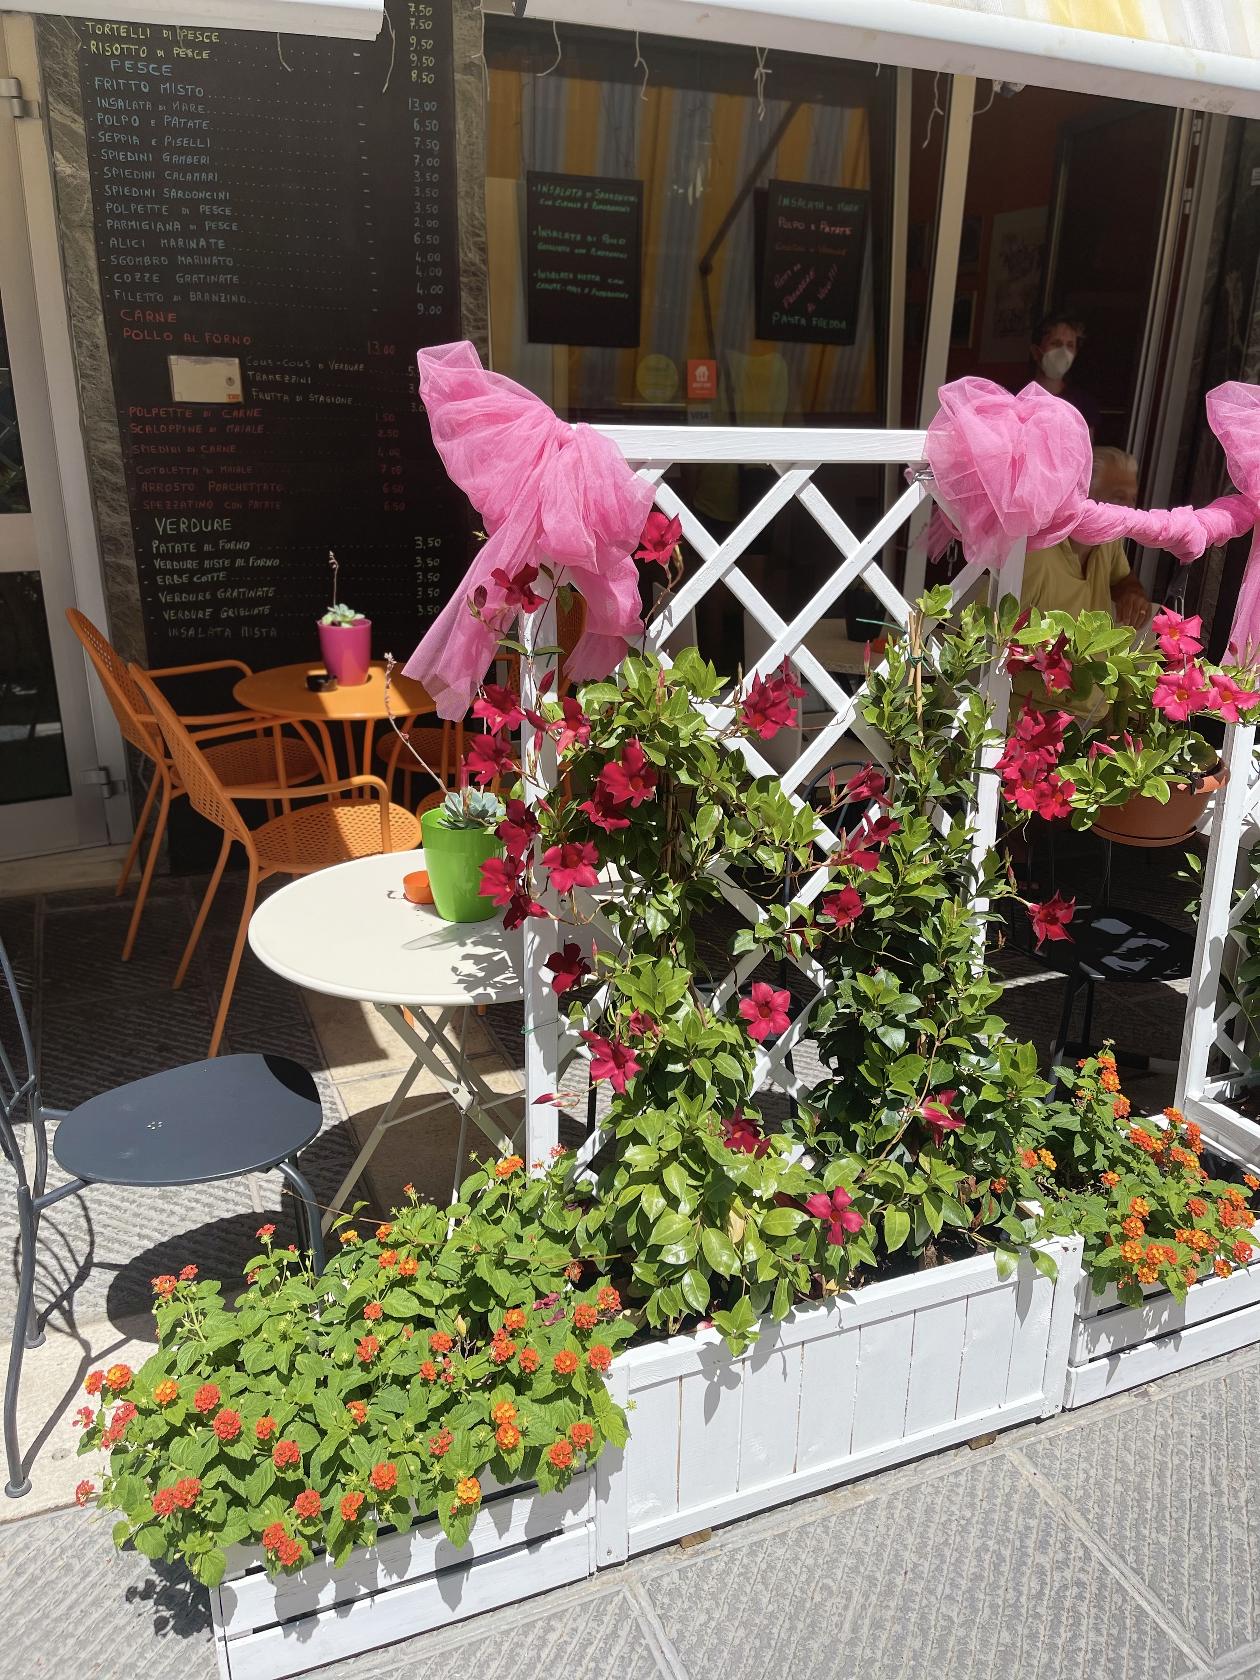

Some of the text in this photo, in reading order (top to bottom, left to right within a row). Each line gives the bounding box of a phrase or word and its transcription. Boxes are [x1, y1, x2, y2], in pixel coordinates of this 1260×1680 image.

[85, 22, 150, 39] TORTELLI
[180, 30, 220, 43] PESCE
[90, 41, 147, 57] RISOTTO
[173, 47, 210, 59] PESCE
[110, 60, 172, 76] PESCE
[95, 77, 149, 92] FRITTO
[160, 83, 204, 97] MISTO
[97, 97, 151, 110] INSALATA
[173, 101, 206, 113] MARE
[97, 113, 140, 127] POLPO
[164, 115, 210, 130] PATATE
[98, 131, 140, 145] SEPPIA
[164, 136, 210, 148] PISELLI
[101, 149, 152, 162] SPIEDINI
[162, 153, 210, 165] GAMBERI
[103, 166, 155, 179] SPIEDINI
[164, 170, 218, 182] CALAMARI
[104, 184, 155, 197] SPIEDINI
[162, 188, 230, 200] SARDONCINI
[105, 202, 169, 215] POLPETTE
[200, 204, 232, 216] PESCE
[106, 219, 181, 232] PARMIGIANA
[205, 221, 239, 231] PESCE
[110, 237, 145, 249] ALICI
[160, 238, 226, 249] MARINATE
[110, 255, 169, 266] SGOMBRO
[178, 255, 233, 266] MARINATO
[114, 273, 161, 283] COZZE
[176, 273, 240, 285] GRATINATE
[114, 290, 163, 302] FILETTO
[190, 292, 246, 303] BRANZINO
[120, 309, 177, 323] CARNE
[123, 328, 173, 341] POLLO
[184, 332, 199, 343] AL
[204, 332, 251, 345] FORNO
[248, 371, 311, 384] TRAMEZZINI
[309, 394, 352, 405] STAGIONE
[128, 406, 192, 418] POLPETTE
[222, 408, 262, 418] CARNE
[129, 422, 201, 434] SCALOPPINE
[226, 424, 264, 434] MAIALE
[201, 445, 237, 454] CARNE
[136, 466, 199, 476] COTOLETTA
[142, 482, 195, 492] ARROSTO
[144, 500, 214, 511] SPEZZATINO
[154, 517, 232, 536] VERDURE
[152, 540, 197, 554] PATATE
[219, 539, 250, 551] FORNO
[154, 558, 199, 570] VERDURE
[249, 556, 280, 567] FORNO
[156, 574, 190, 585] ERBE
[193, 571, 227, 582] COTTE
[159, 591, 211, 603] VERDURE
[216, 587, 276, 599] GRATINATE
[163, 608, 214, 620] VERDURE
[168, 626, 277, 638] INSALATA MISTA
